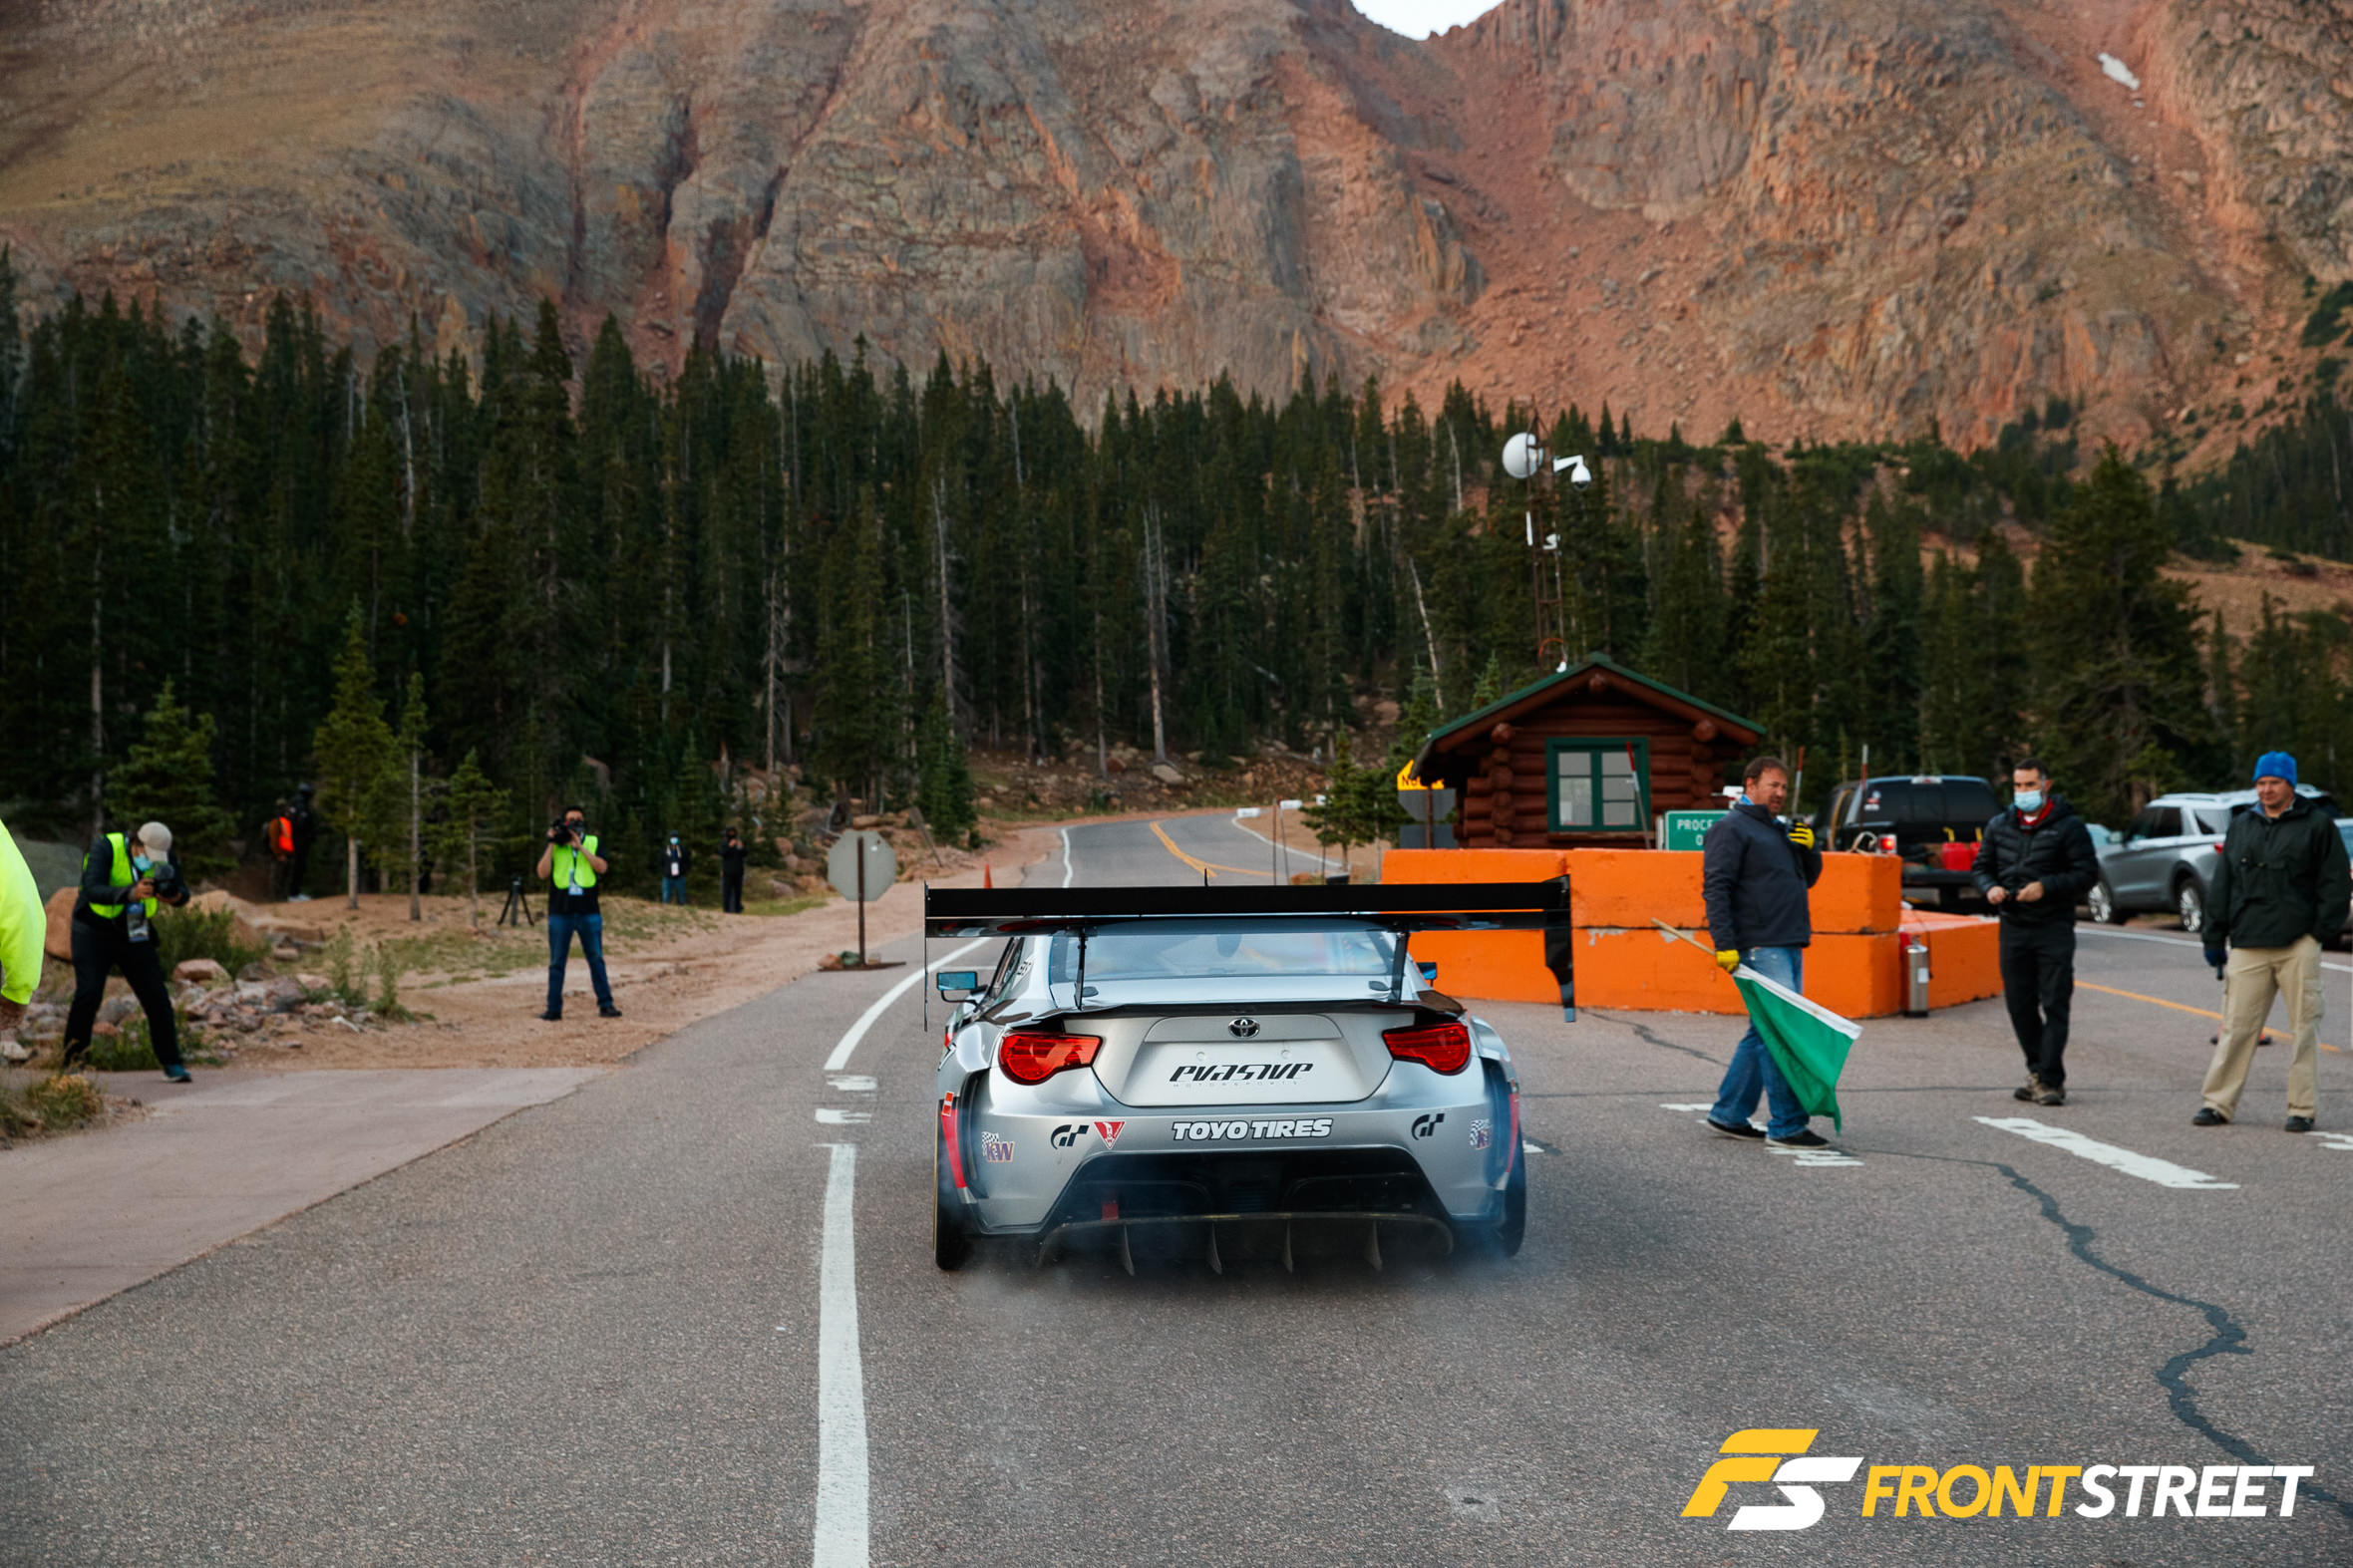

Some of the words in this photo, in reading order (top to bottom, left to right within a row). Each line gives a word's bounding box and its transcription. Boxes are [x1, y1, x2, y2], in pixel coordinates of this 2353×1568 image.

[1676, 818, 1715, 831] PROCE
[1173, 1120, 1248, 1140] TOYO
[1250, 1117, 1334, 1138] TIRES
[985, 1140, 1015, 1163] KW
